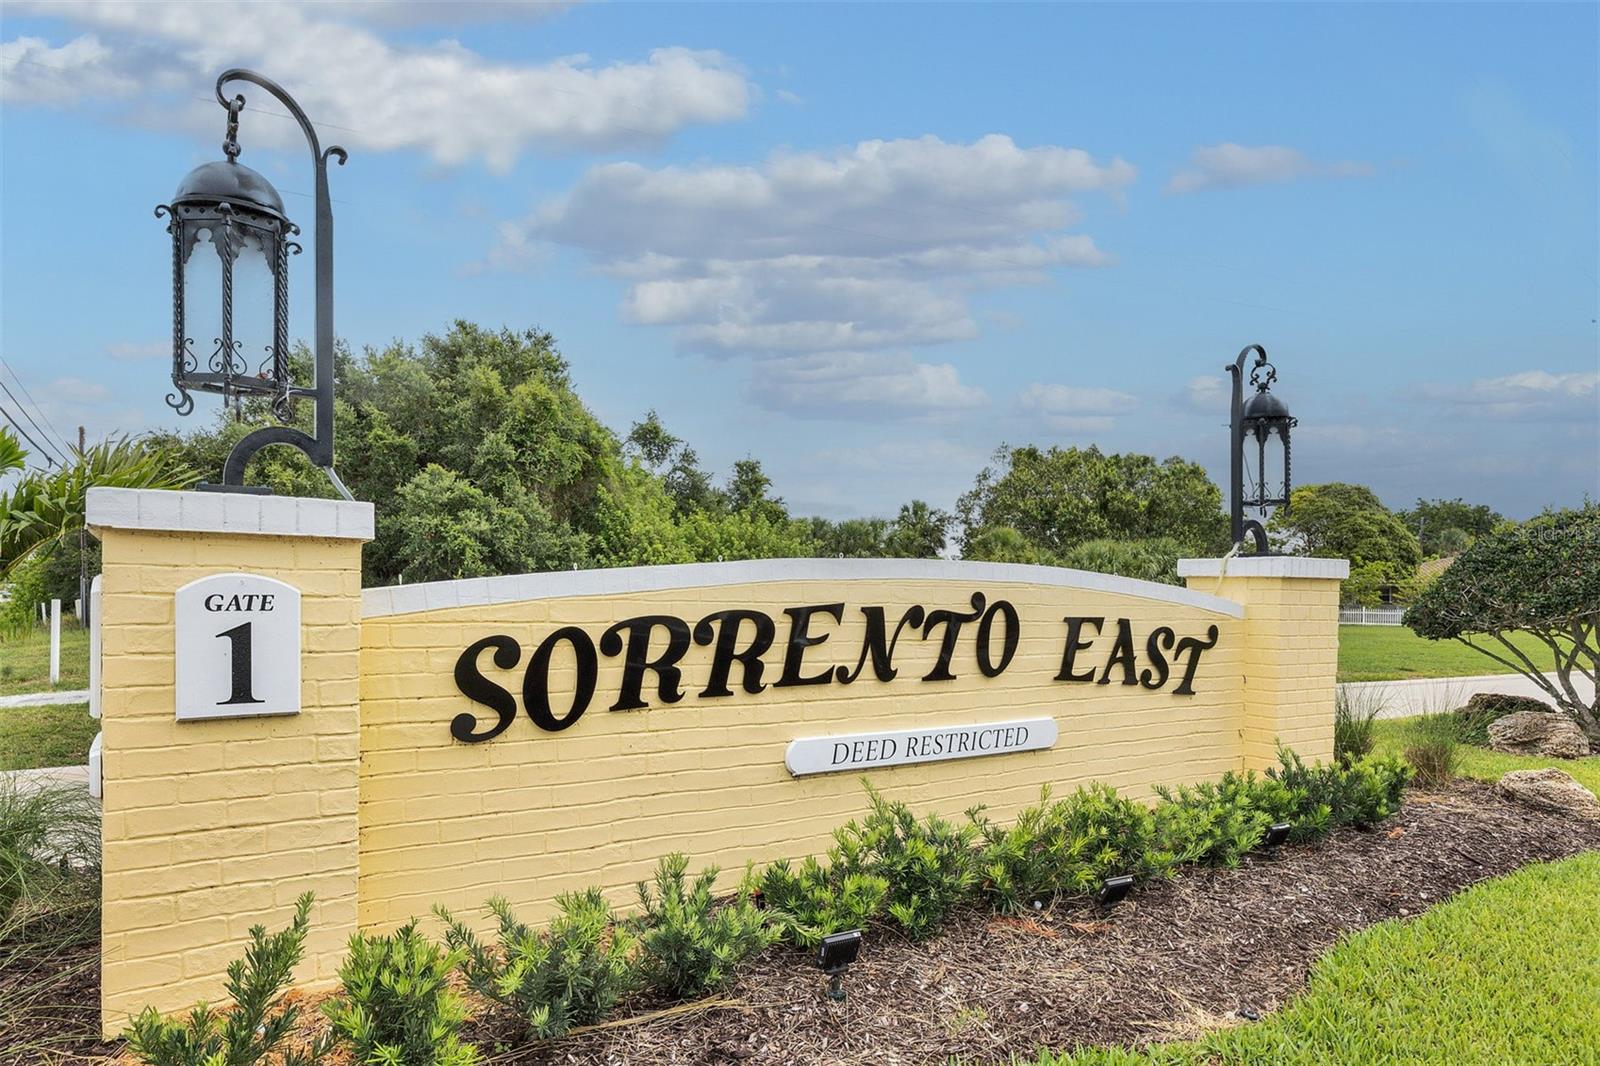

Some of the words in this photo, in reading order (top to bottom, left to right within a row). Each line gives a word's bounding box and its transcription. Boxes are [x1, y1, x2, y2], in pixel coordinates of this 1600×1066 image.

[204, 593, 275, 612] GATE
[215, 621, 266, 706] 1
[450, 592, 1020, 746] SORRENTO
[1053, 616, 1219, 696] EAST
[831, 738, 898, 765] DEED
[905, 726, 1030, 758] RESTRICTED
